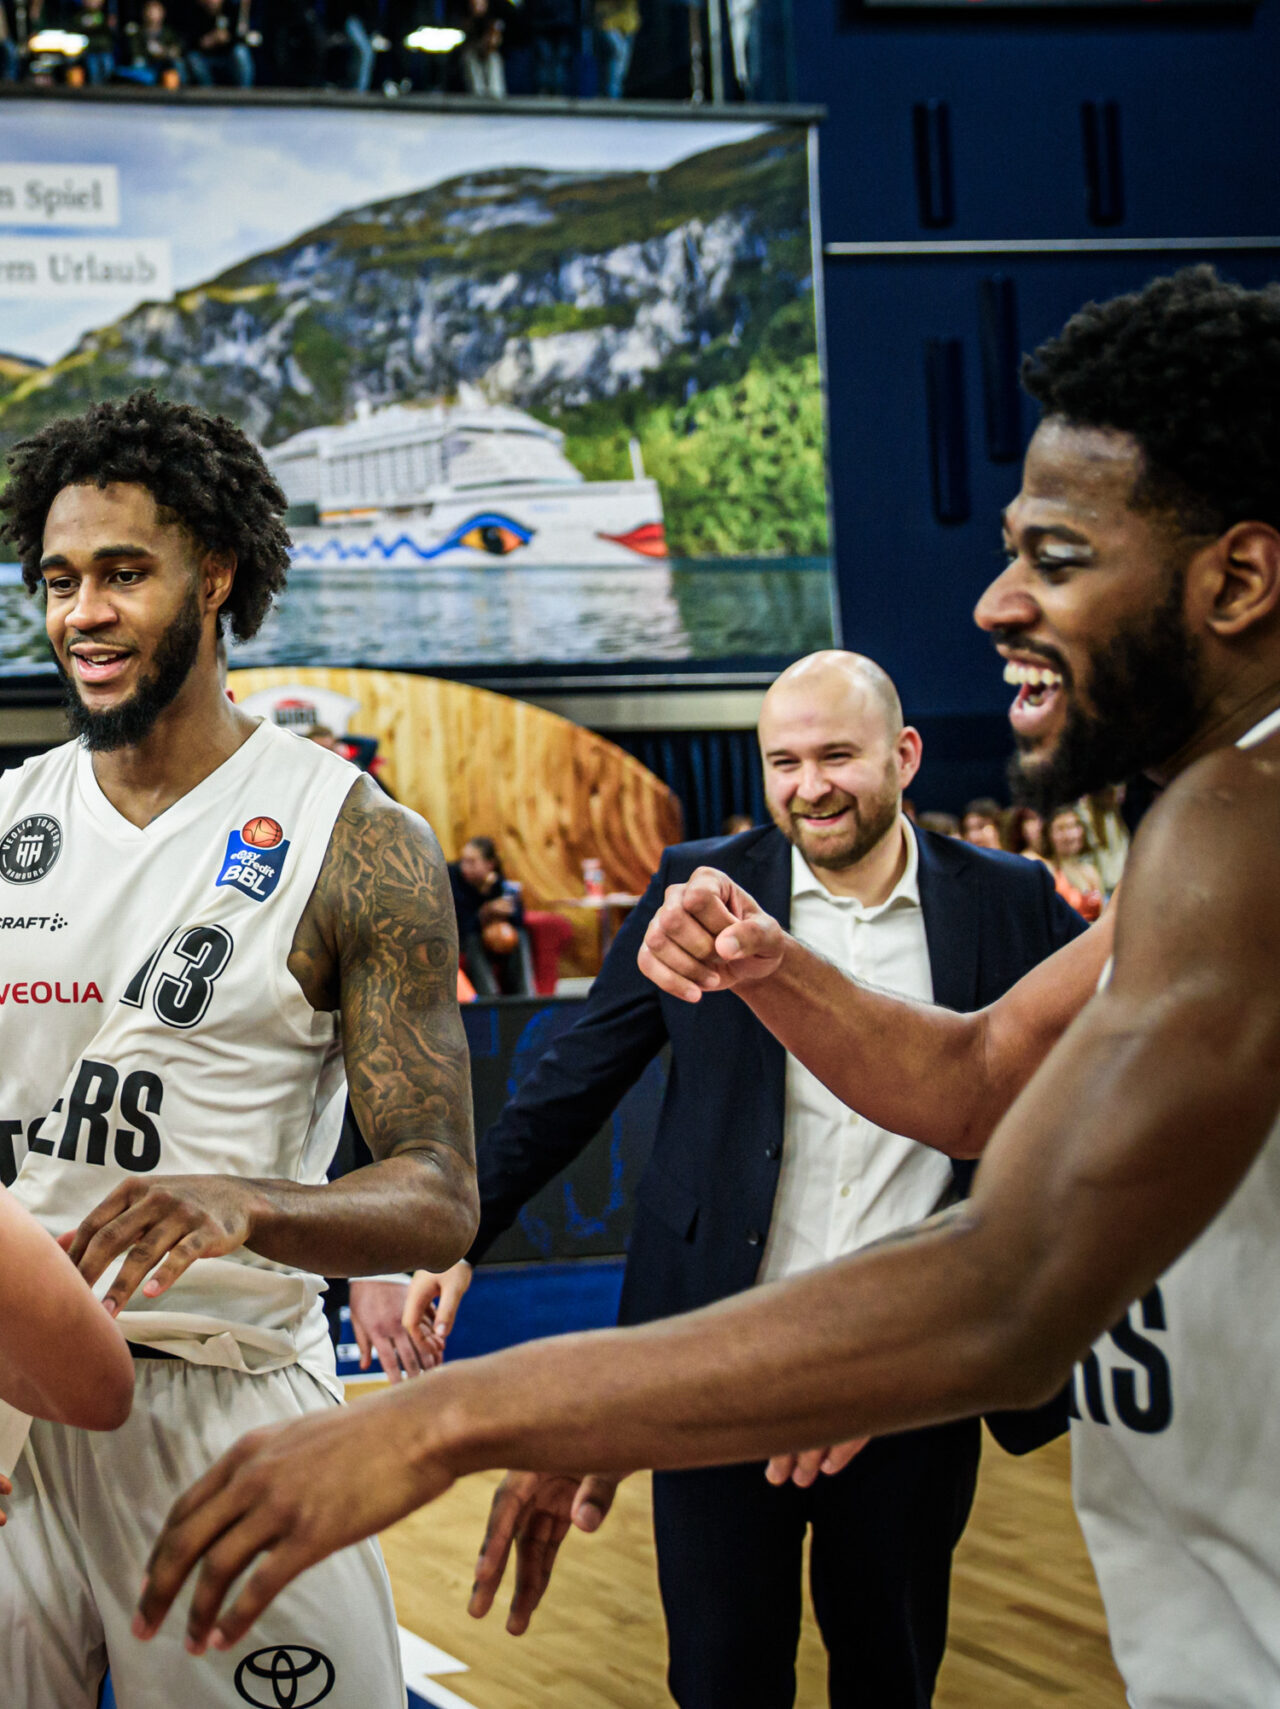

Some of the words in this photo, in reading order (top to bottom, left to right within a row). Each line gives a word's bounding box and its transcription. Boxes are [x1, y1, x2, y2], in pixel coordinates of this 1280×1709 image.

[25, 178, 103, 217] Spiel
[48, 253, 156, 284] Urlaub
[2, 819, 33, 850] VEOLIA
[36, 817, 61, 848] TOWERS
[15, 842, 43, 868] HH
[230, 850, 261, 861] easy
[240, 857, 276, 879] Credit
[5, 866, 45, 880] HAMBURG
[221, 864, 266, 897] BBL
